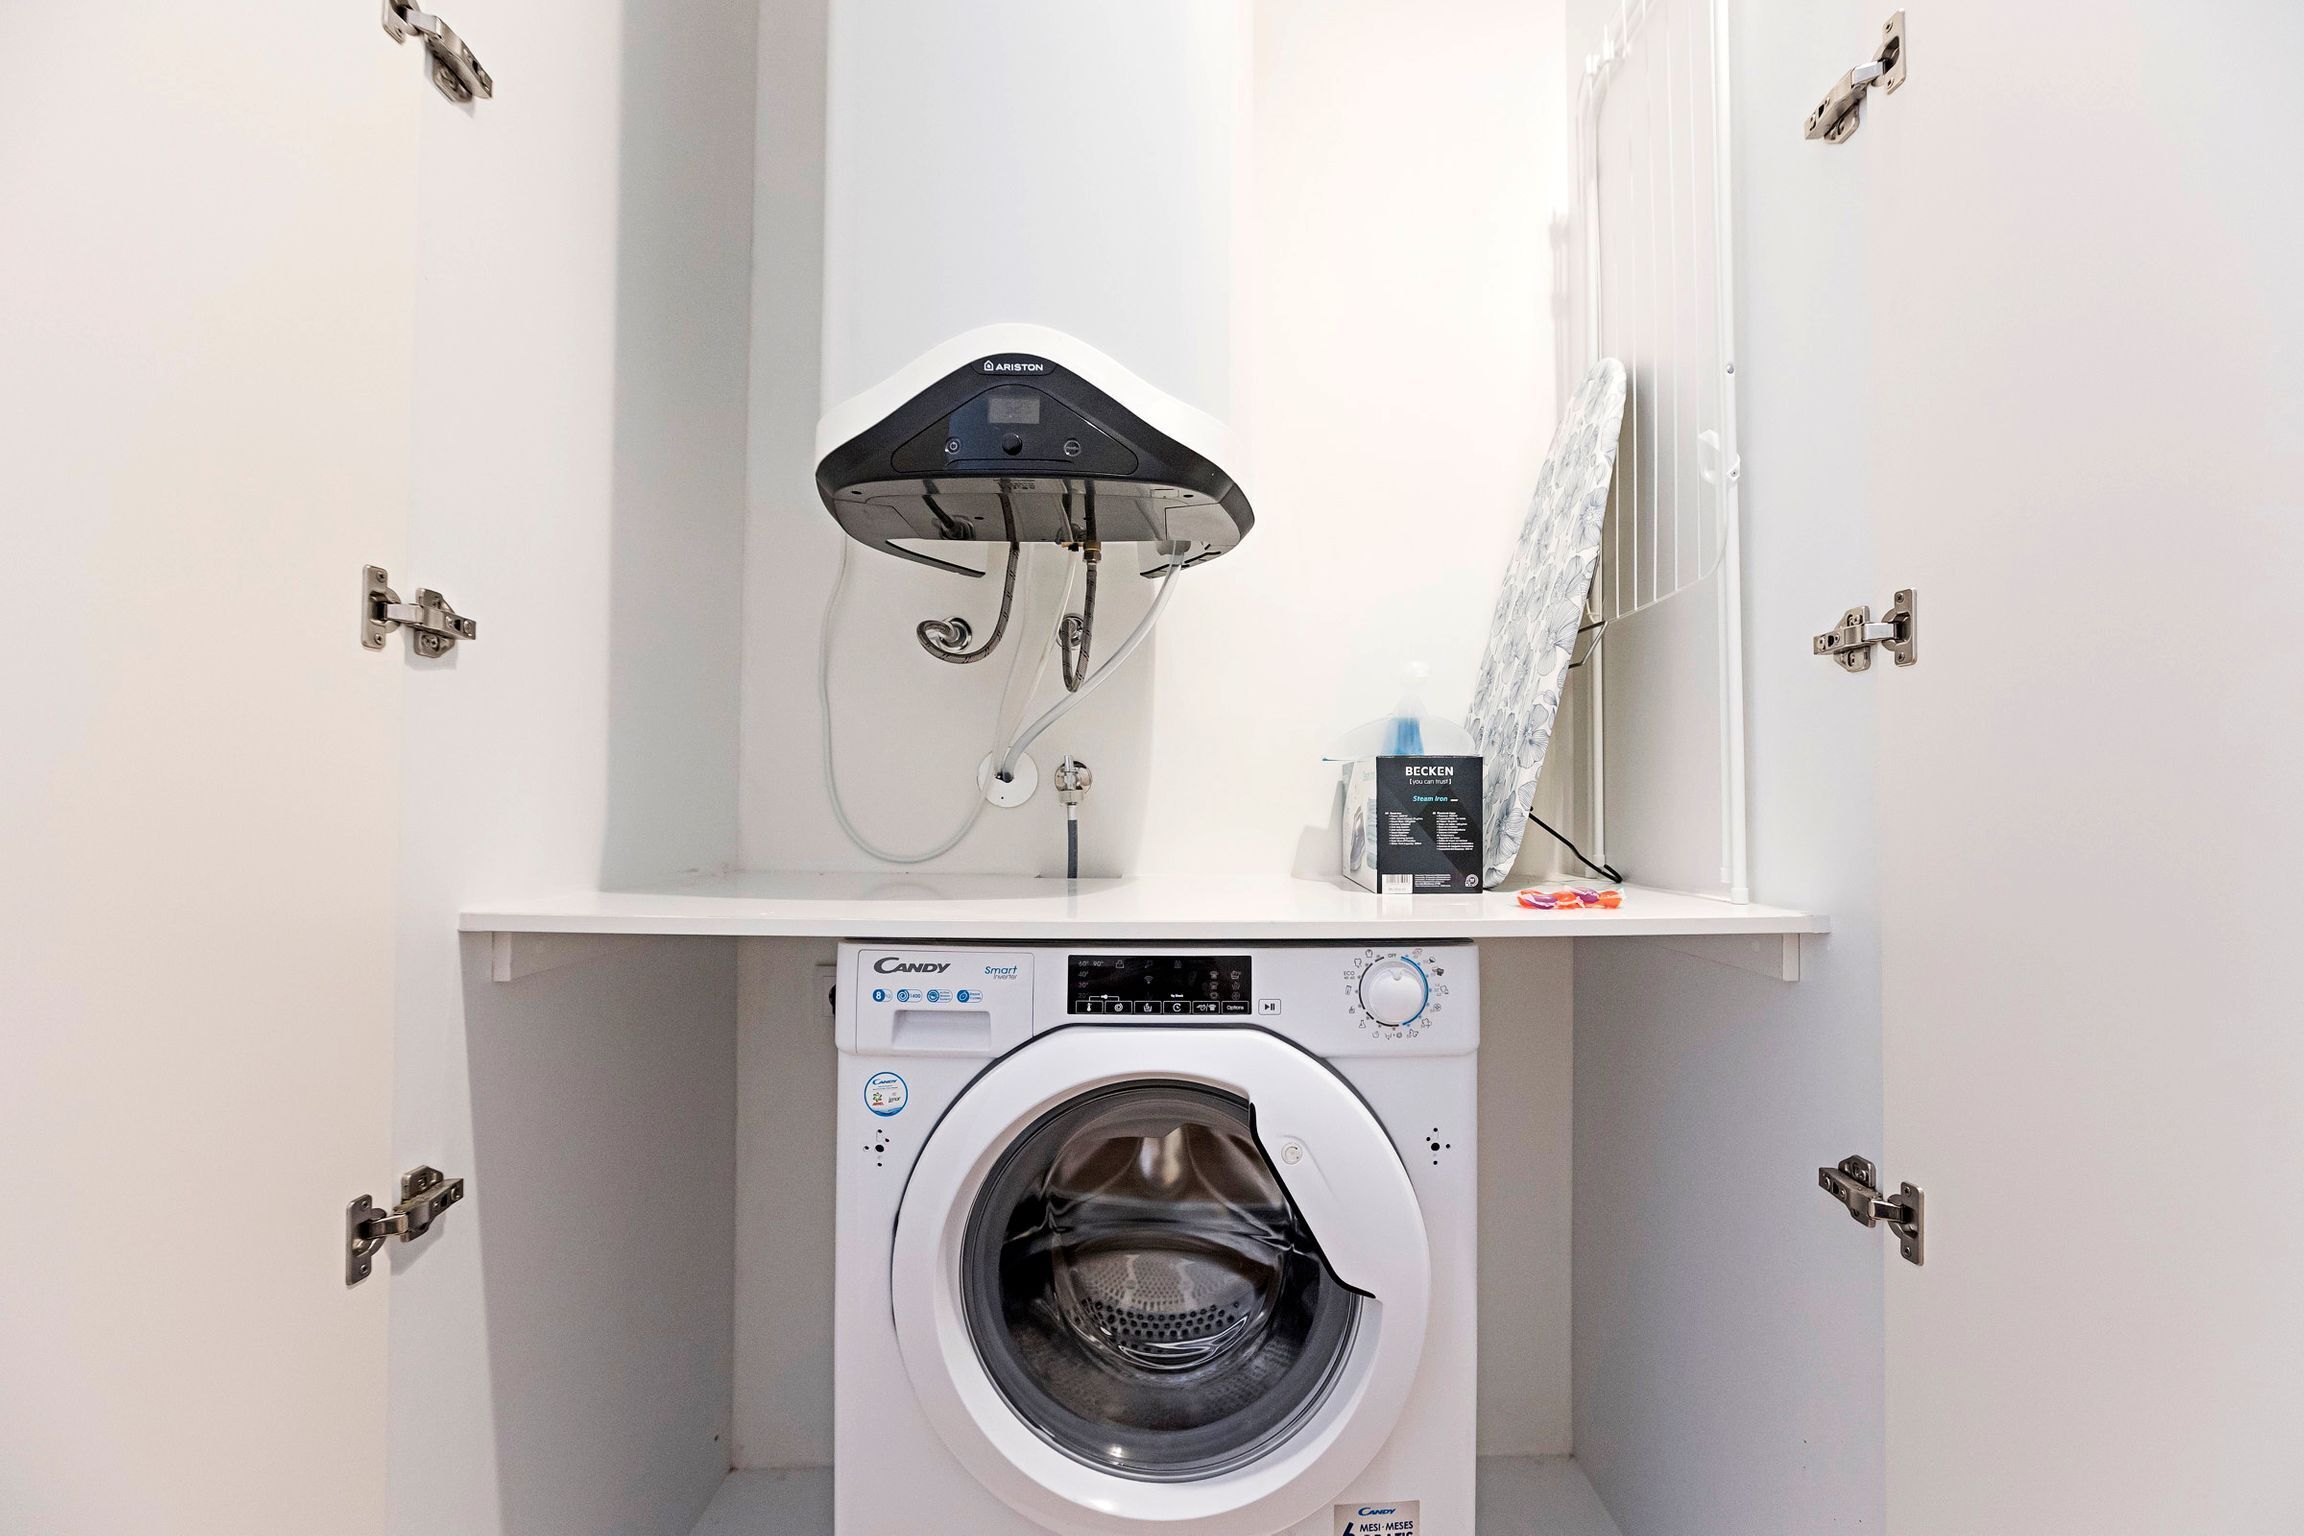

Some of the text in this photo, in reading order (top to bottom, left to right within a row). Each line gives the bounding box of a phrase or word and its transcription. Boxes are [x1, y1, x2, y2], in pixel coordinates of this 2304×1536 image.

[995, 363, 1044, 371] ARISTON
[1405, 766, 1454, 776] BECKEN
[984, 965, 1018, 975] Smart
[875, 990, 883, 1000] 8
[1360, 1523, 1380, 1532] MESI
[1386, 1521, 1413, 1531] MESES
